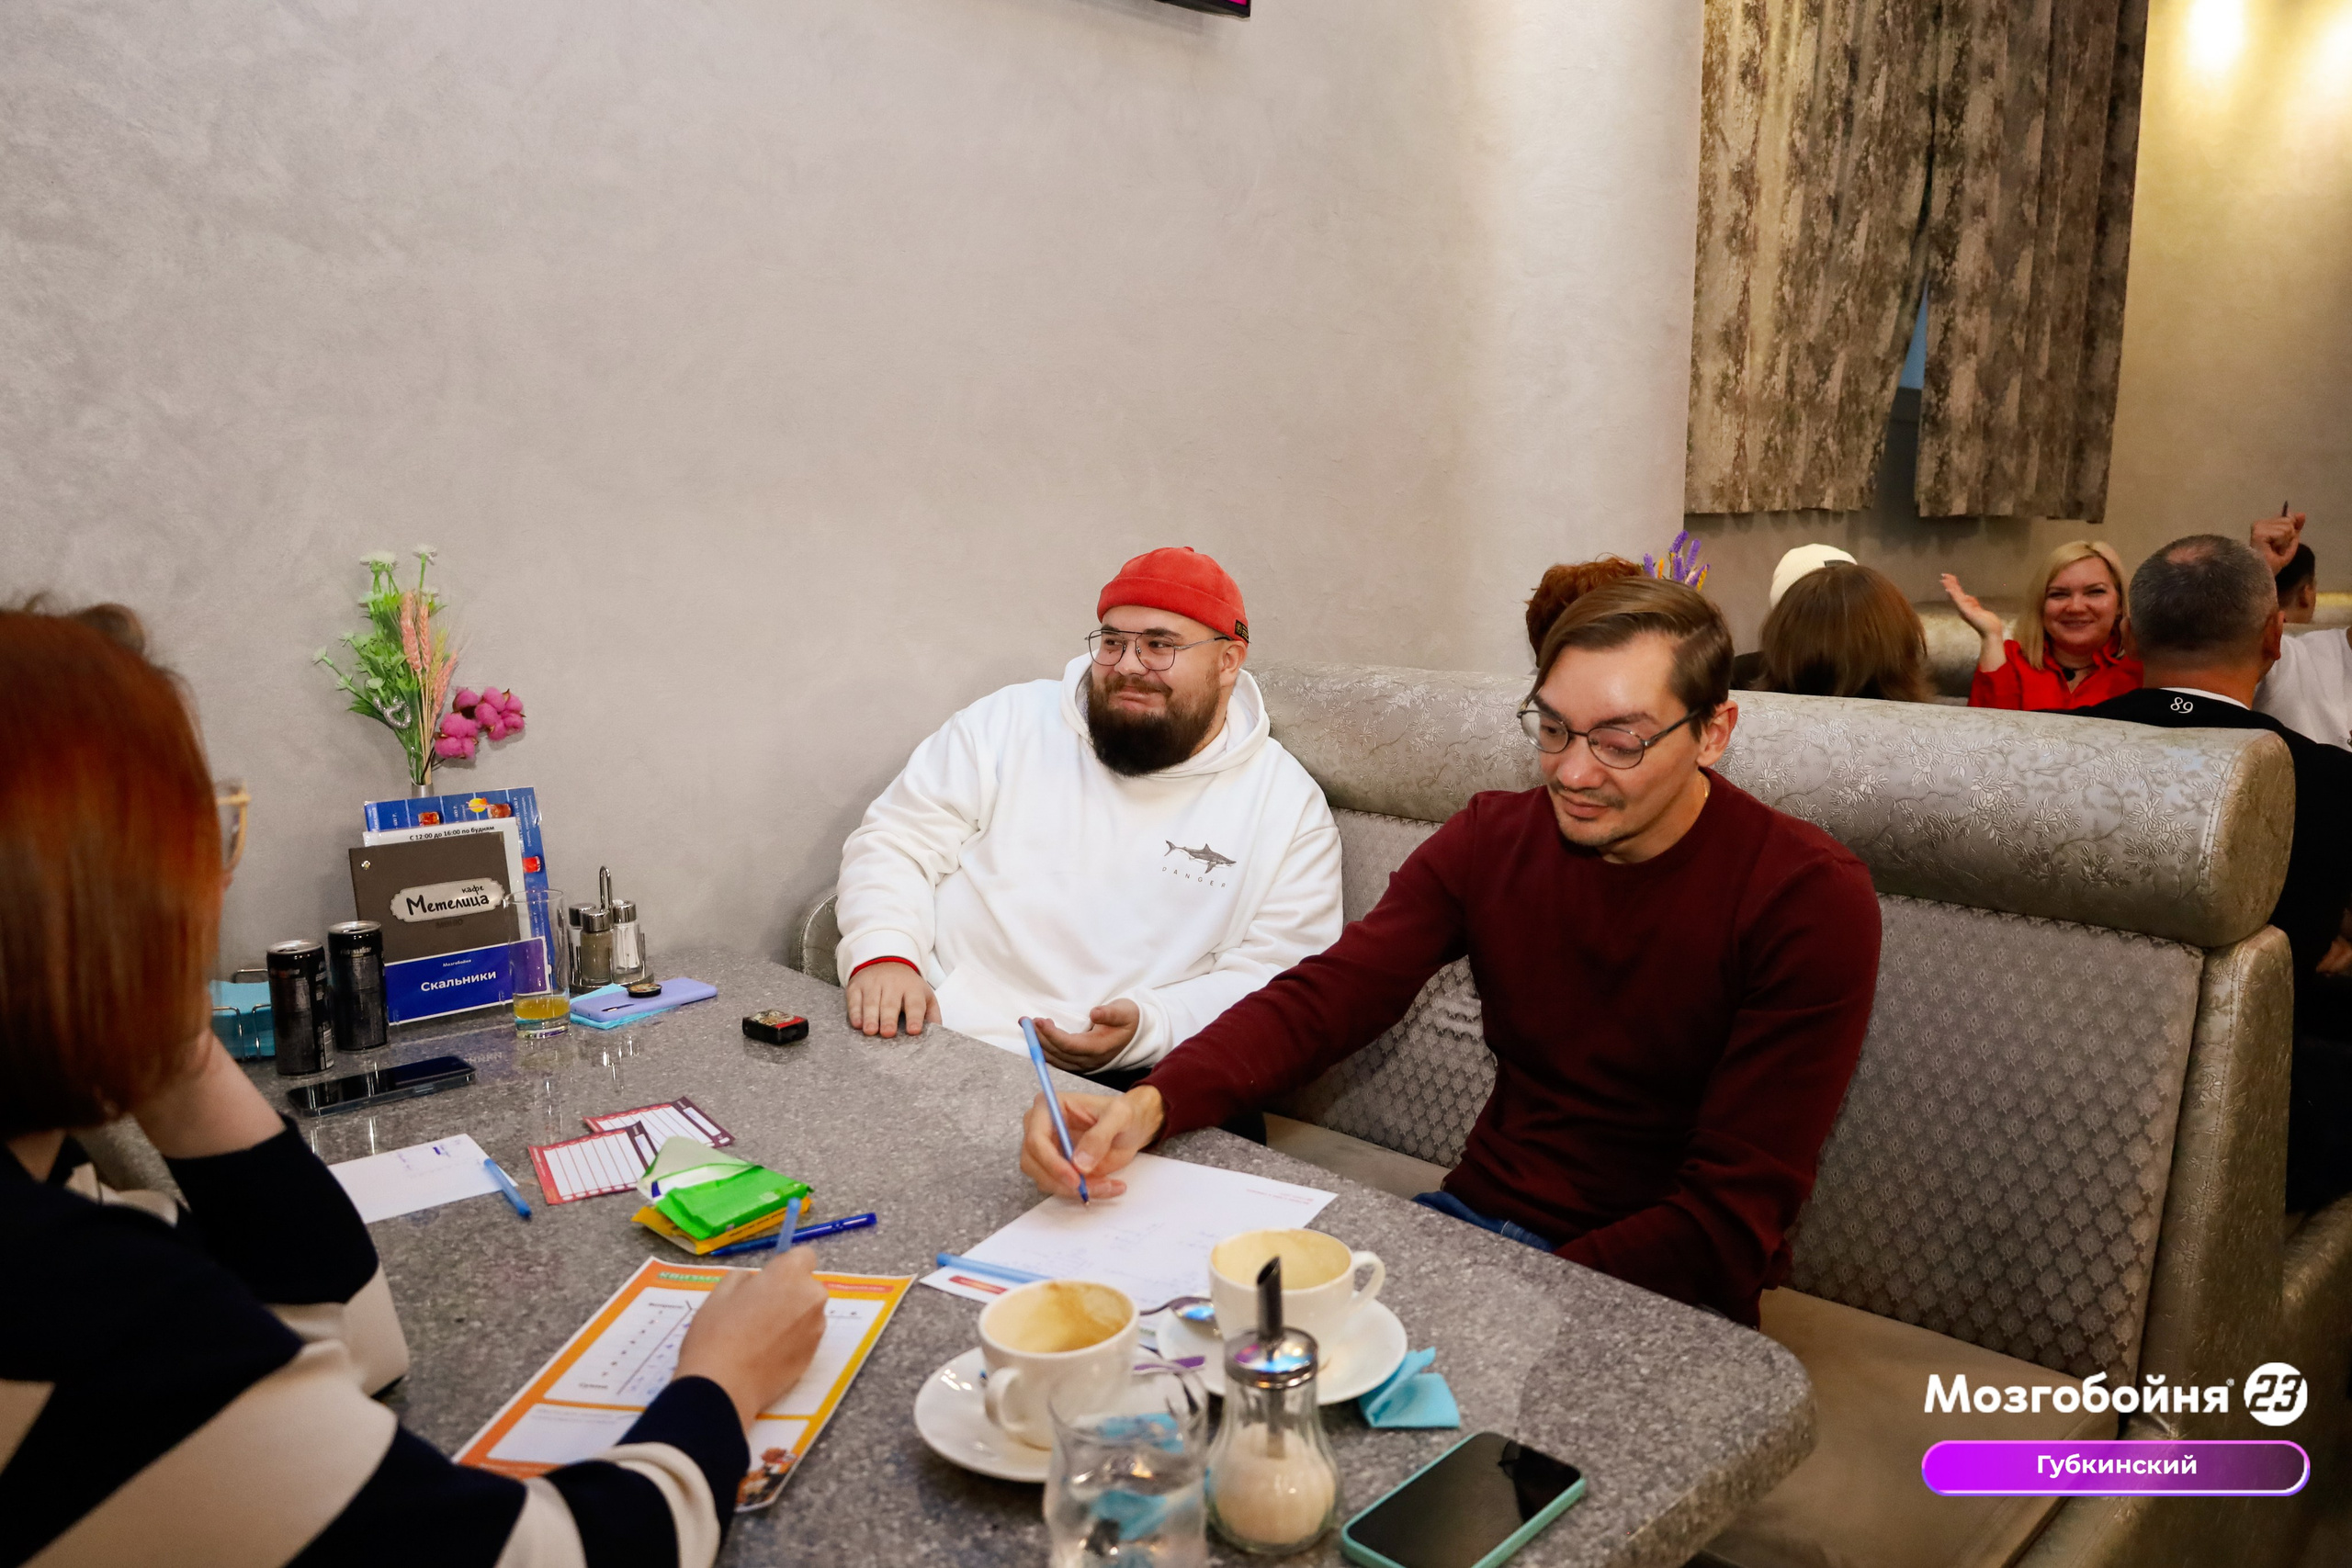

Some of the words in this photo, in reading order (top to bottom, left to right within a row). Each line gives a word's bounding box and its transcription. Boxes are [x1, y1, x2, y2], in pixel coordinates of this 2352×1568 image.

[2170, 696, 2194, 714] 89
[470, 826, 494, 834] будням
[1162, 866, 1226, 888] DANGER
[461, 885, 484, 895] кафе
[406, 894, 489, 916] Метелица
[442, 959, 471, 967] Мозгобойня
[421, 971, 496, 991] Скальники
